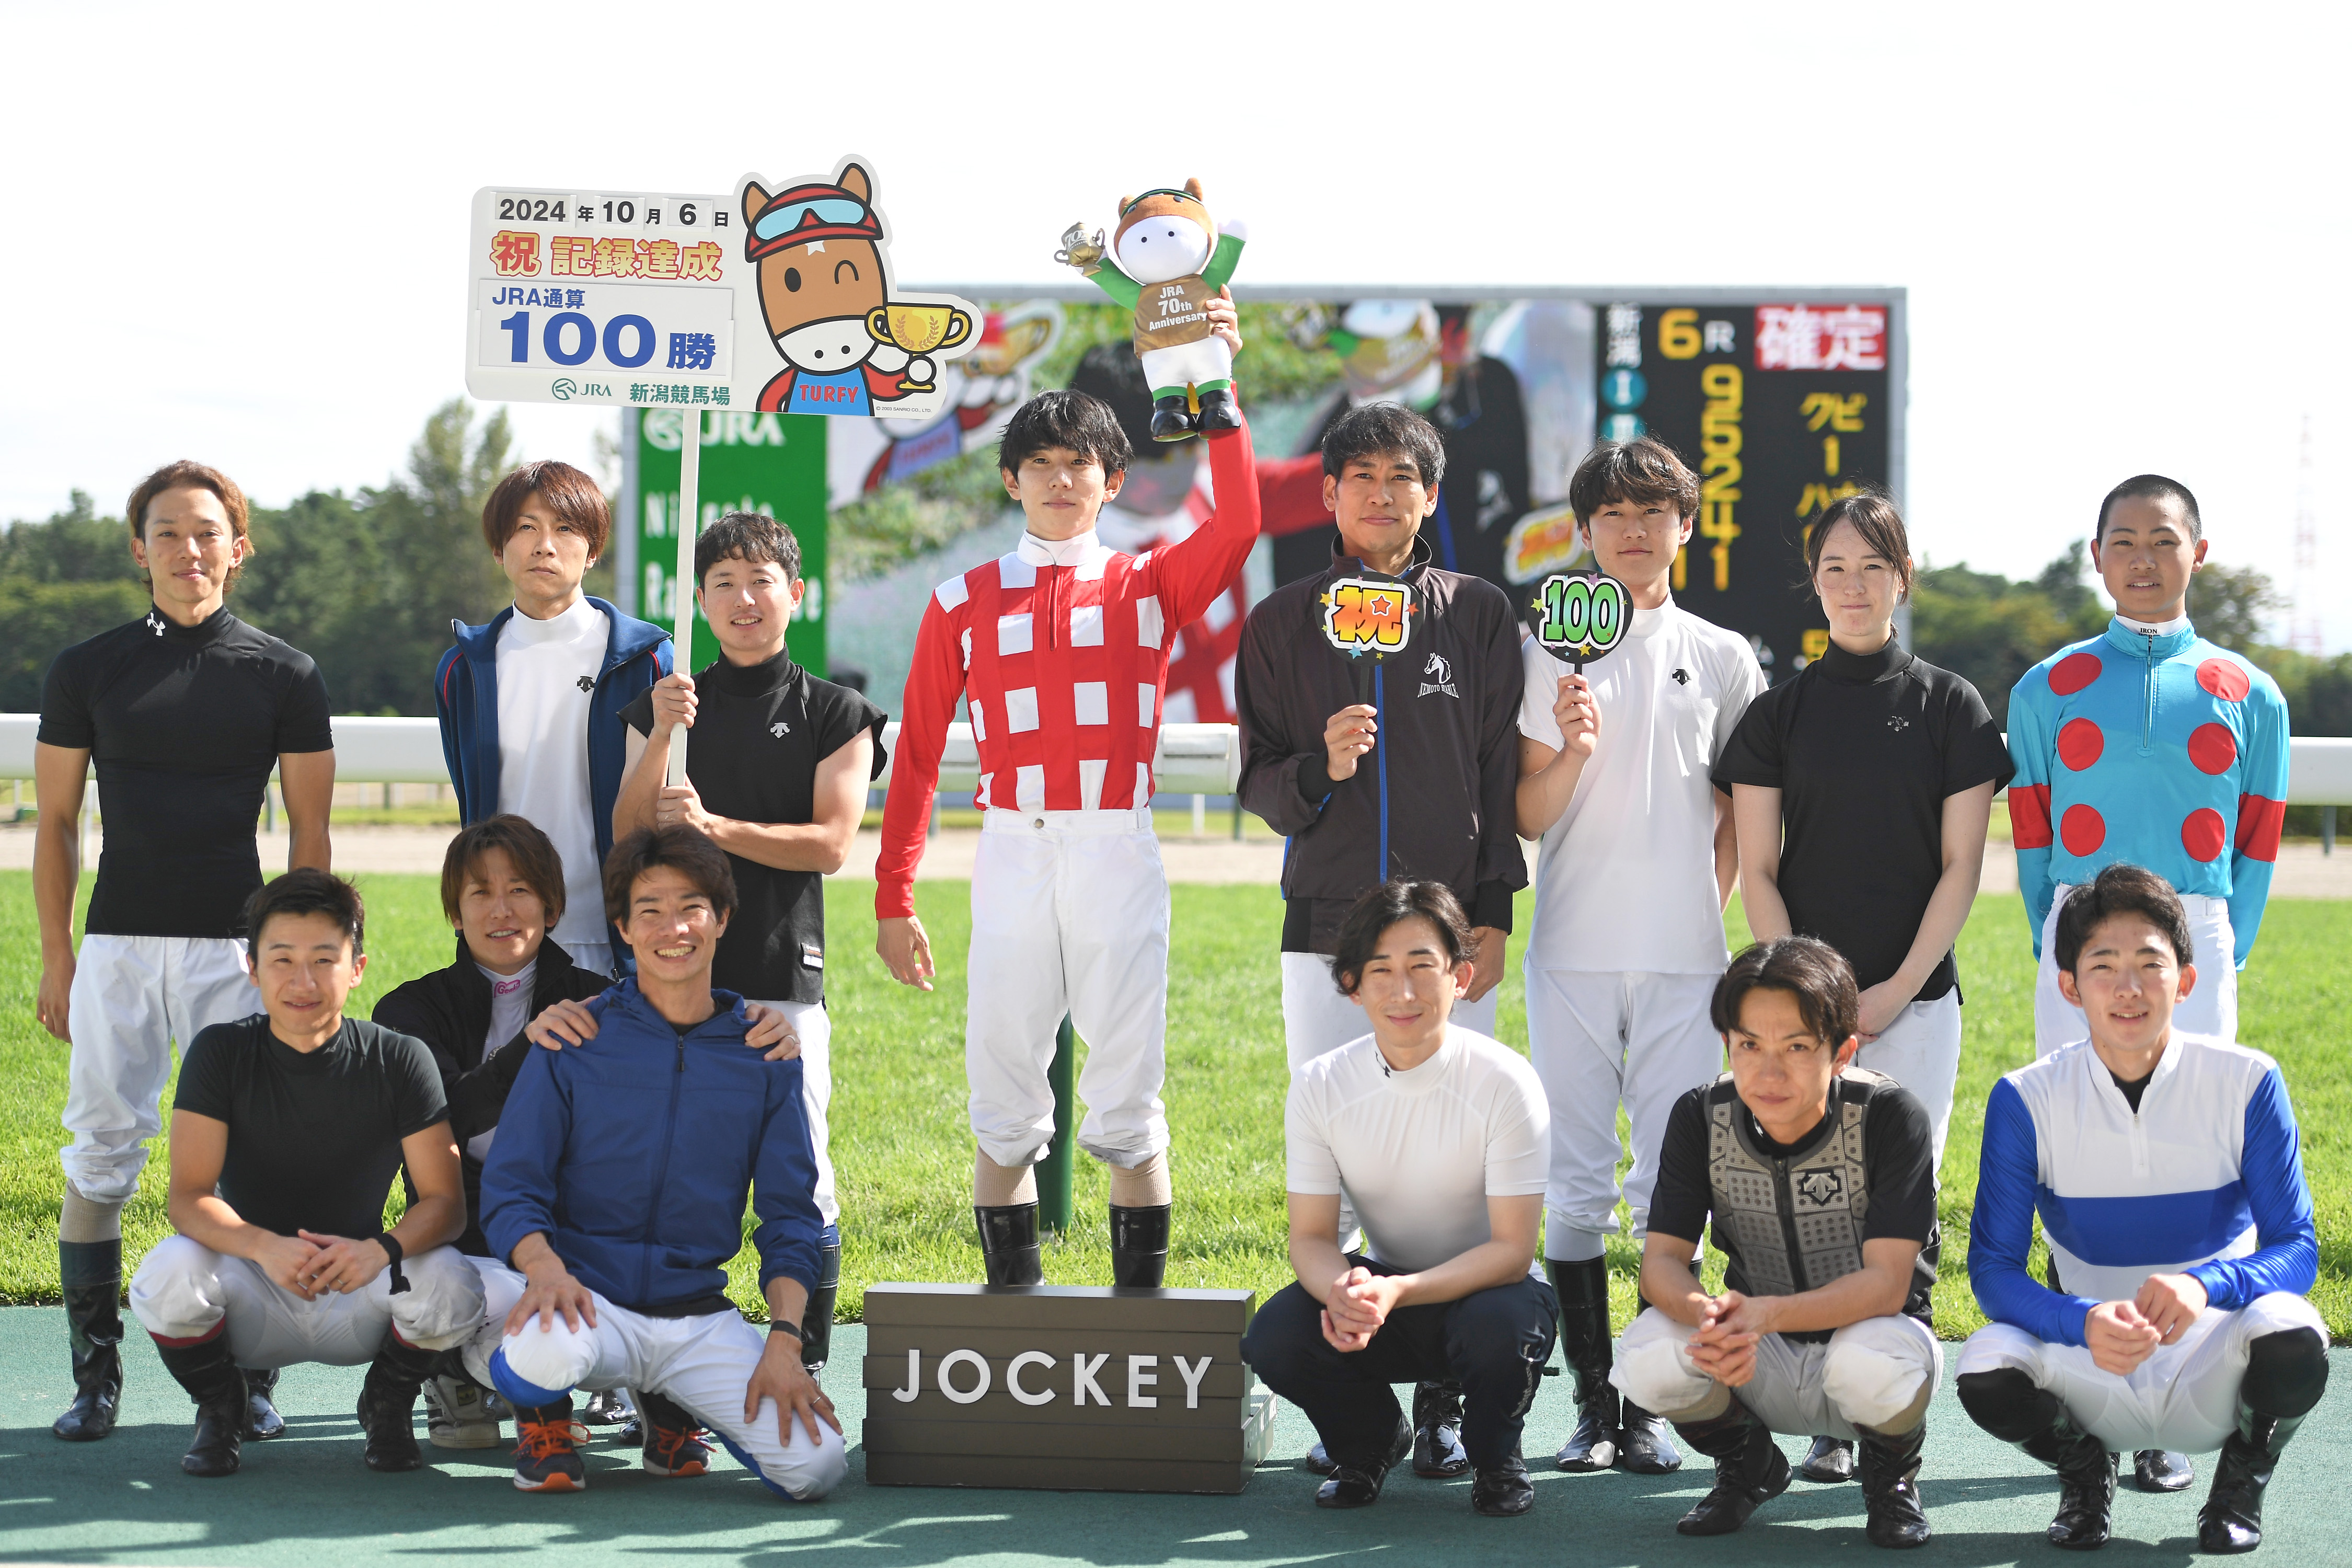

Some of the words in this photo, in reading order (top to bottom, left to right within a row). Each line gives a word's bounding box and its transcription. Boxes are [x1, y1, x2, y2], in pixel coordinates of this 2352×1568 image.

[499, 199, 566, 222] 2024
[578, 205, 594, 222] 年
[603, 201, 635, 223] 10
[645, 208, 661, 225] 月
[679, 203, 697, 225] 6
[714, 211, 729, 227] 日
[490, 231, 541, 276] 祝
[551, 236, 723, 281] 記録達成
[492, 286, 586, 309] JRA通算
[1159, 284, 1185, 299] JRA
[1158, 298, 1193, 316] 70th
[1149, 312, 1208, 331] Anniversary
[1658, 308, 1702, 360] 6
[1704, 320, 1736, 353] R
[1756, 303, 1886, 371] 確定
[580, 383, 612, 397] JRA
[629, 383, 731, 406] 新潟競馬場
[799, 384, 859, 403] TURFY
[1800, 391, 1869, 433] クビ
[1331, 584, 1405, 645] 祝
[1543, 580, 1621, 644] 100
[1417, 682, 1440, 698] NEMOTO
[1441, 683, 1460, 699] STABLE
[892, 1348, 1213, 1409] JOCKEY
